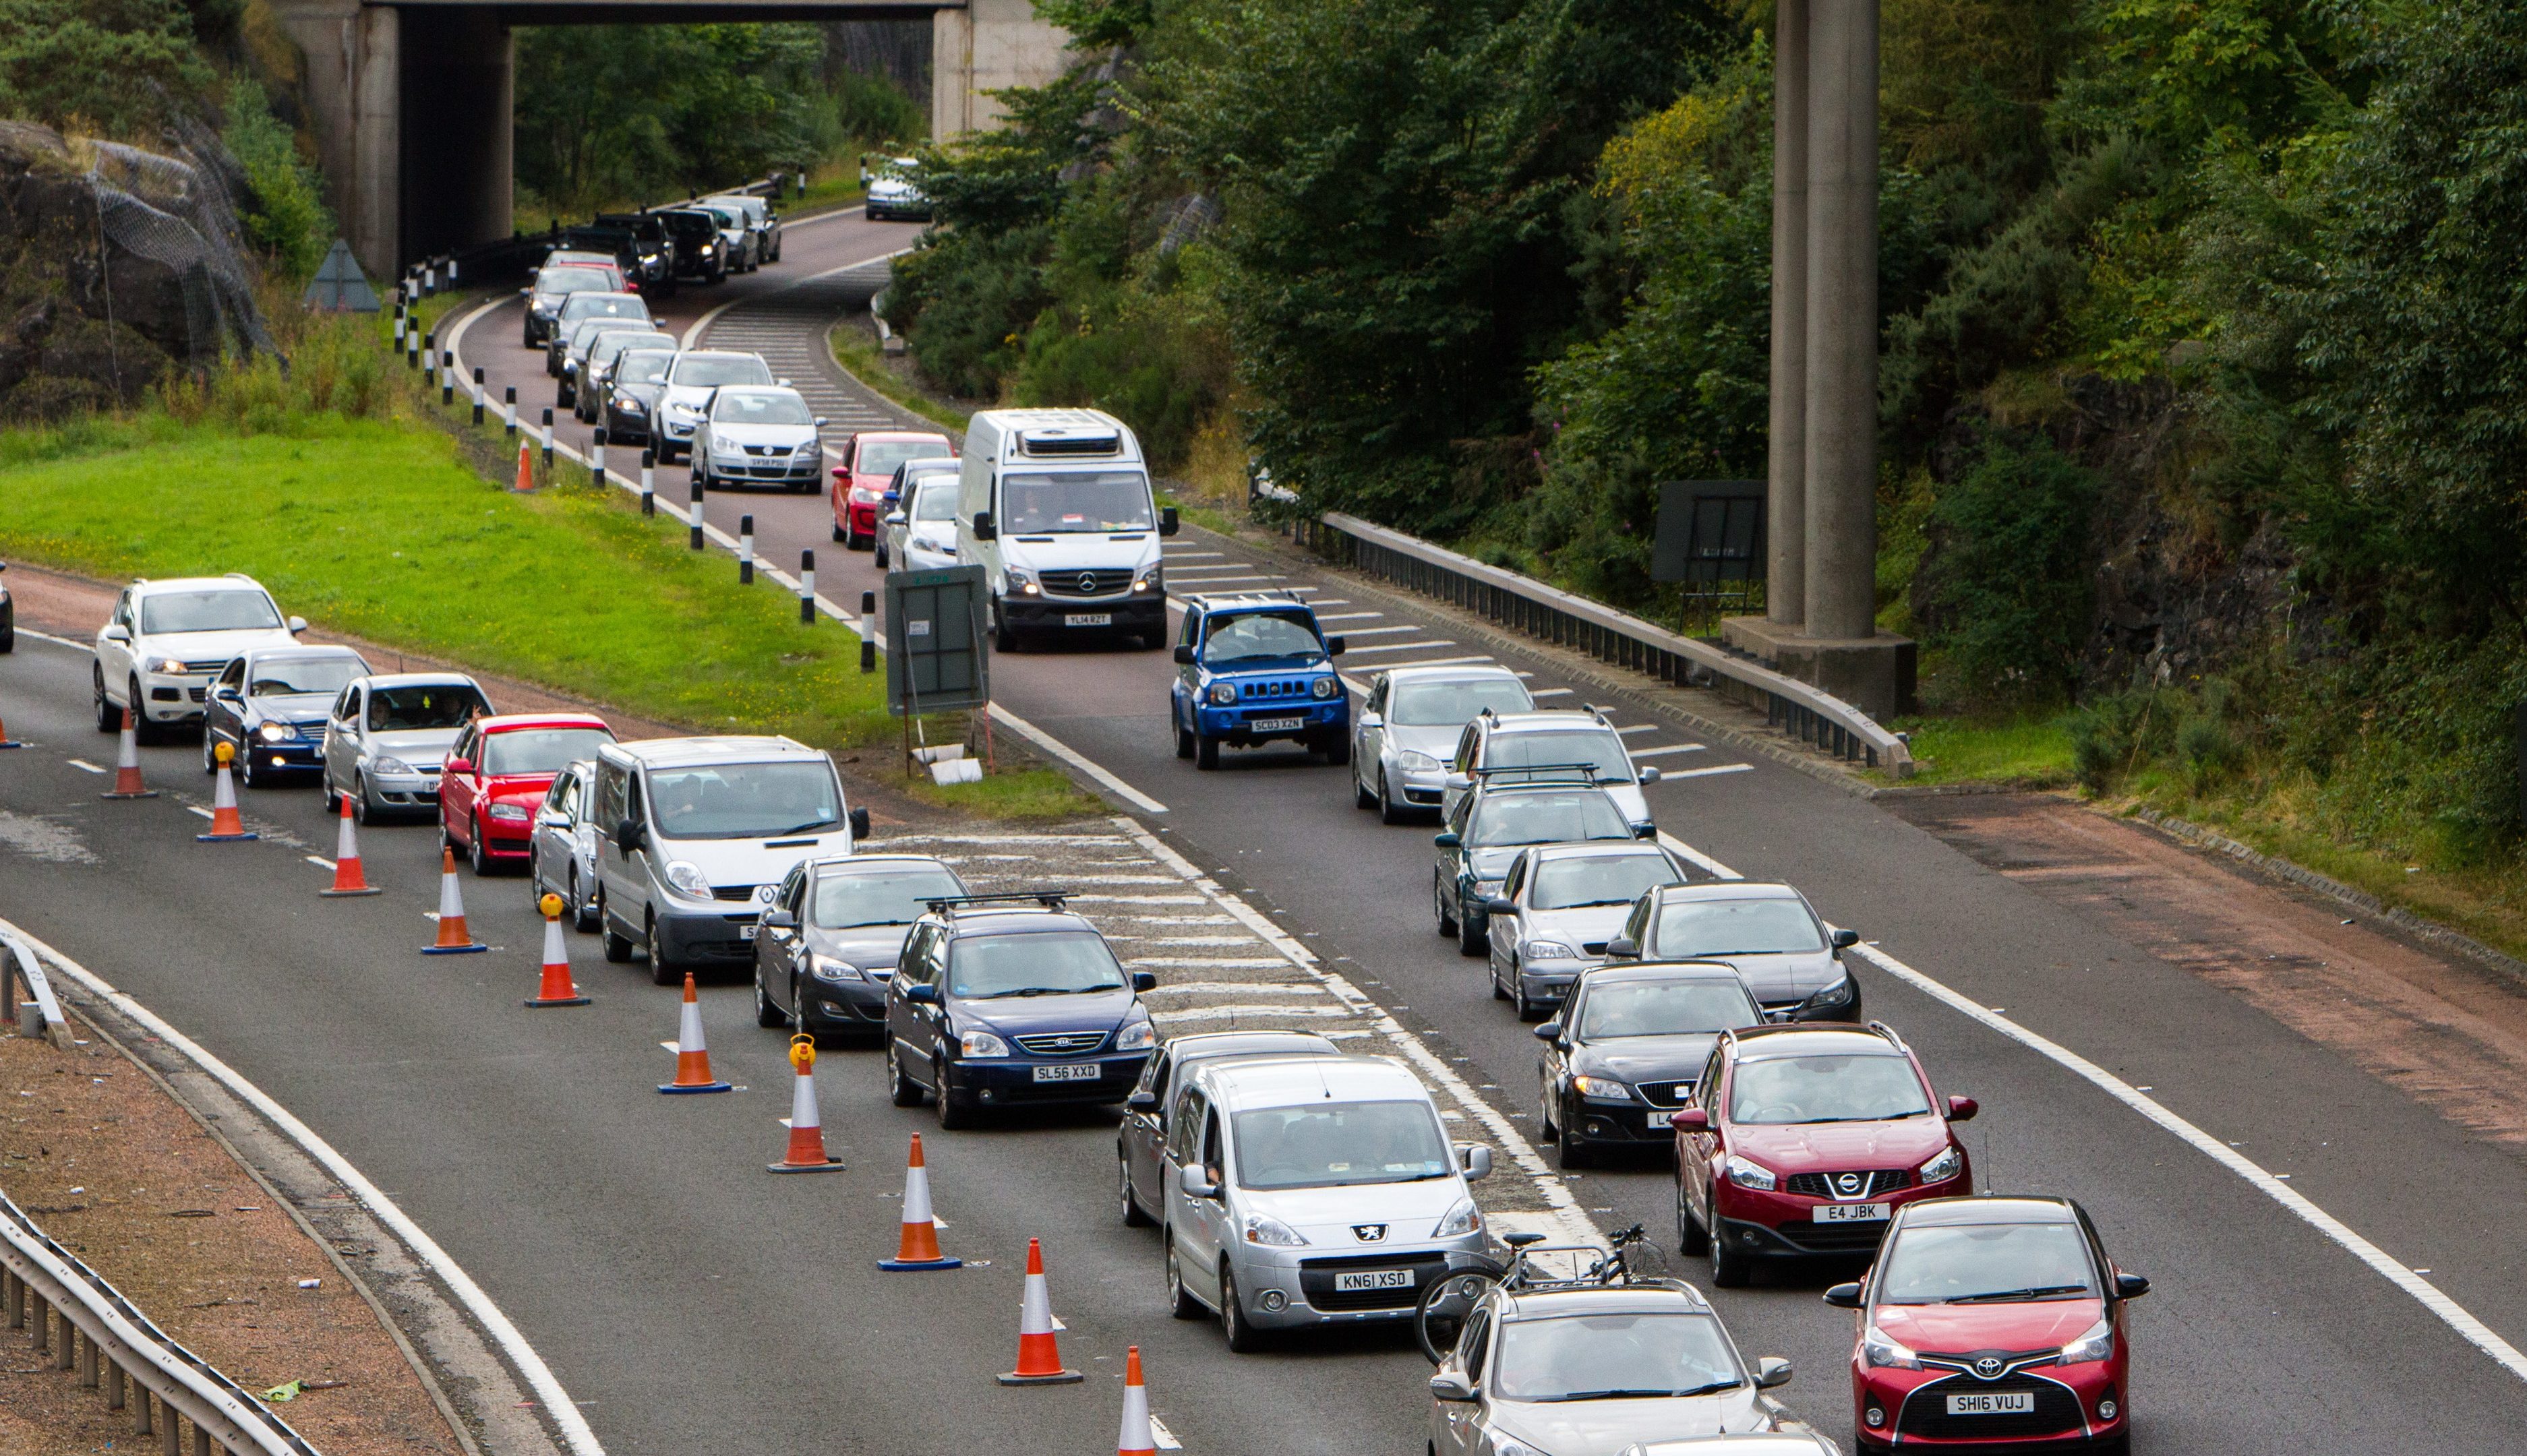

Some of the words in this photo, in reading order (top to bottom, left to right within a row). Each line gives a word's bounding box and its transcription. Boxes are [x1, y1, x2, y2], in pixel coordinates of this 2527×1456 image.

[1255, 720, 1280, 730] SC03
[1282, 719, 1299, 728] XZN
[1038, 1067, 1069, 1079] SL56
[1072, 1066, 1095, 1077] XXD
[1829, 1207, 1846, 1219] E4
[1850, 1205, 1876, 1218] JBK
[1344, 1274, 1375, 1289] KN61
[1379, 1272, 1406, 1287] XSD
[1957, 1396, 1991, 1411] SH16
[1995, 1395, 2024, 1409] VUJ
